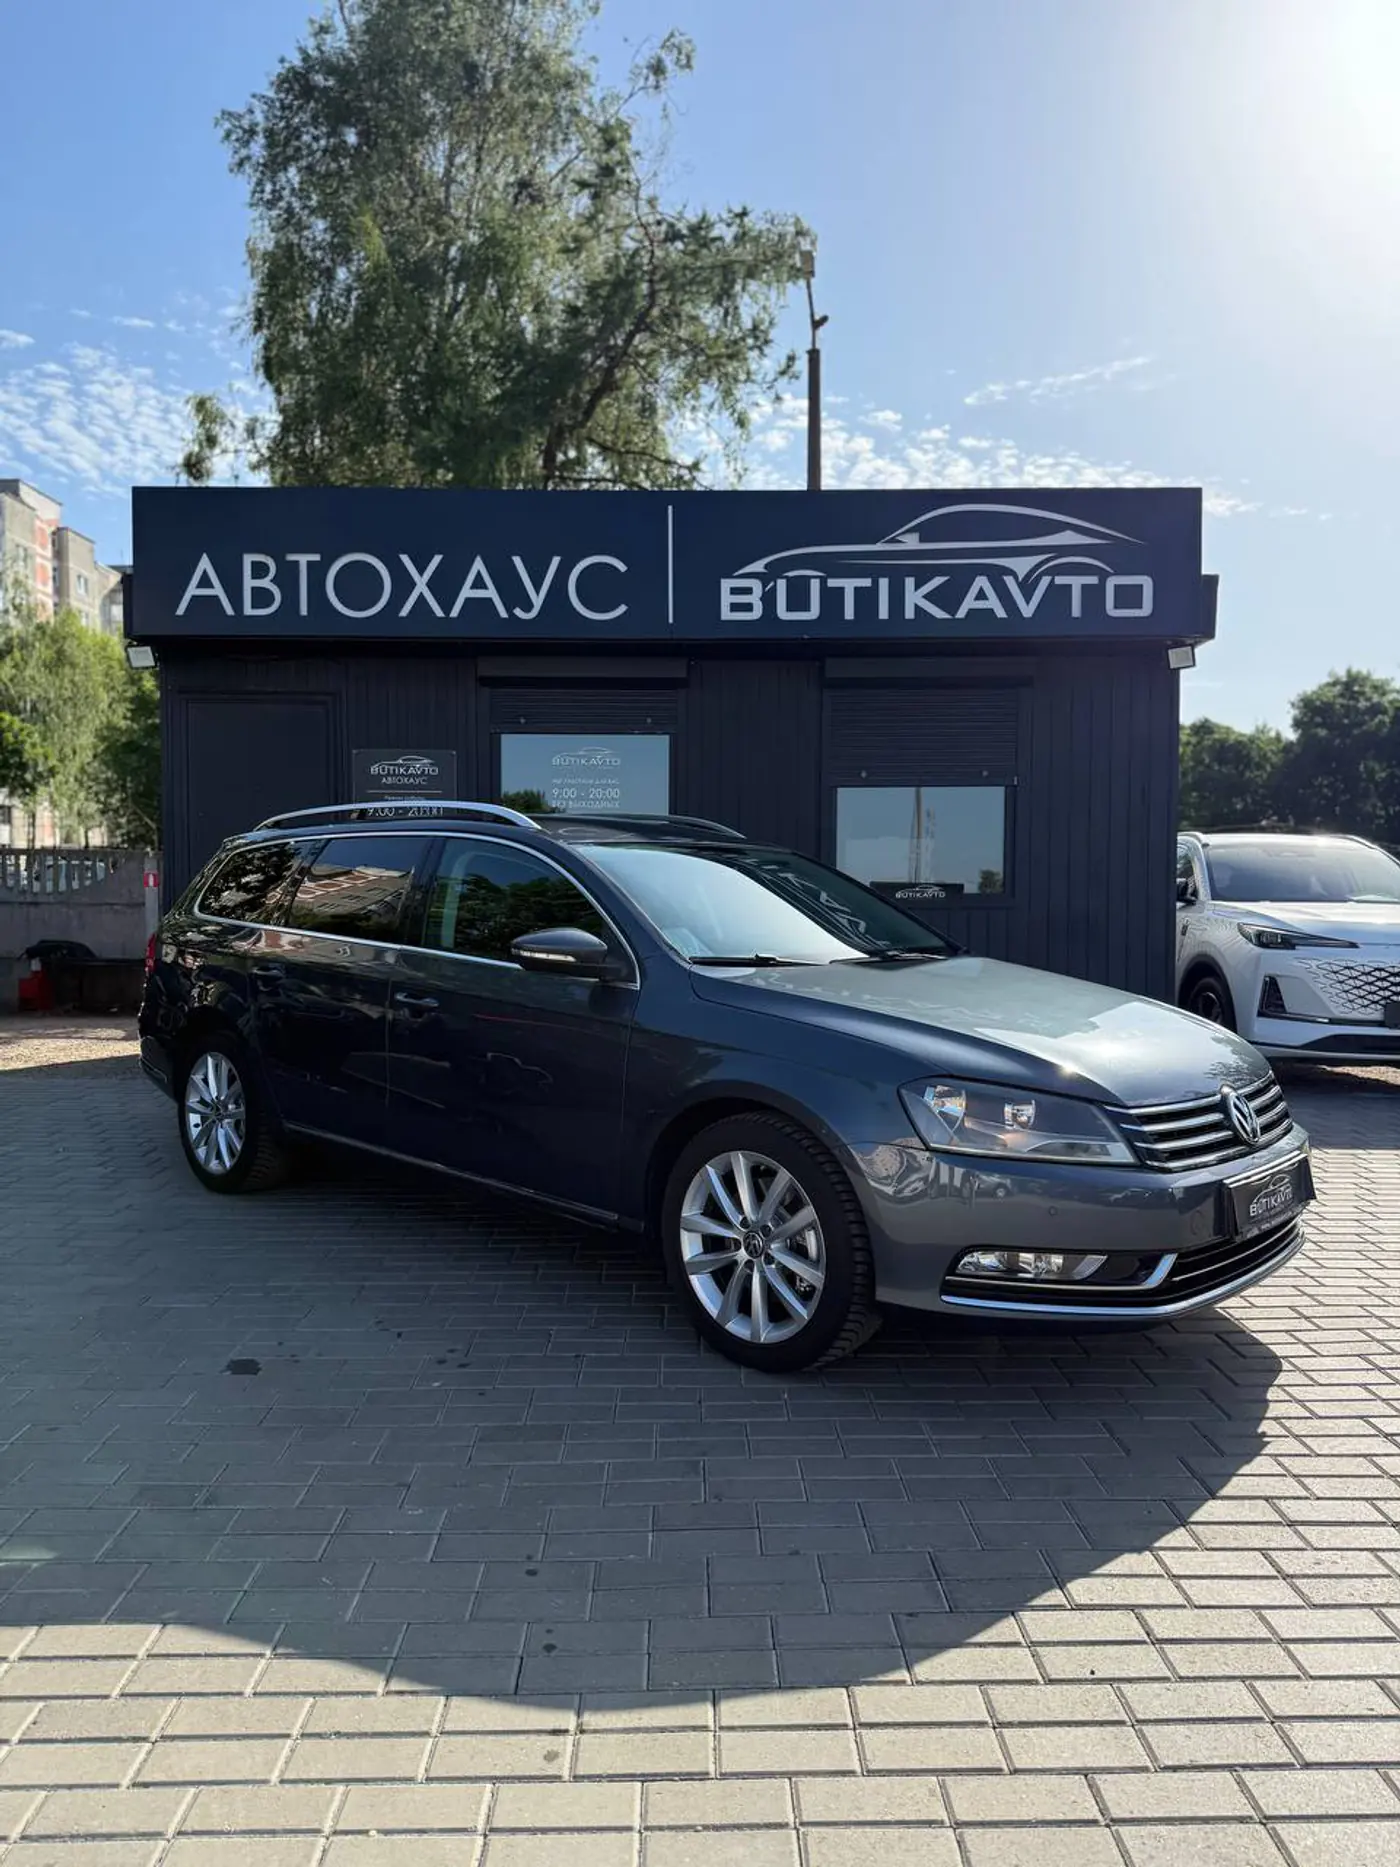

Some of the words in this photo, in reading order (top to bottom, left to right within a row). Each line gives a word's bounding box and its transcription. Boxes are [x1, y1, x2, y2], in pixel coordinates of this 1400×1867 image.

[174, 552, 629, 621] АВТОХАУС
[720, 575, 1154, 621] BUTIKAVTO
[552, 757, 621, 765] BUTIKAVTO
[370, 766, 439, 775] BUTIKAVTO
[381, 777, 428, 785] АВТОХАУС
[552, 787, 577, 799] 9:00
[588, 787, 620, 799] 20:00
